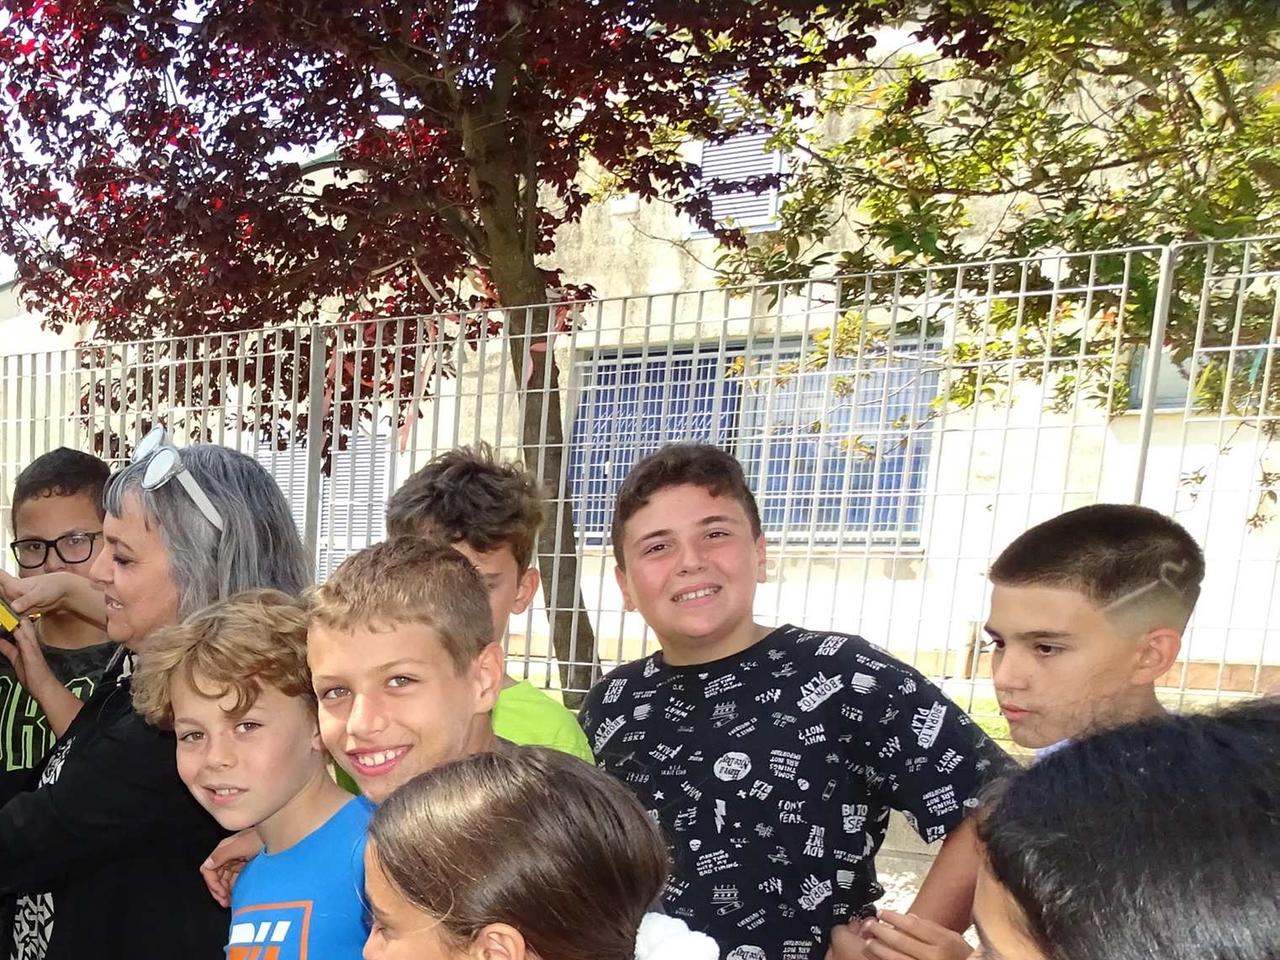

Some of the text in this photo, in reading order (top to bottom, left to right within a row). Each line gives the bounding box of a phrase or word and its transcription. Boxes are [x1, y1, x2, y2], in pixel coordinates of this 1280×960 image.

[800, 671, 826, 697] PLAY
[798, 724, 824, 740] NOT?
[804, 734, 826, 746] WHY
[769, 764, 796, 774] THINGS
[944, 754, 964, 774] WHY
[774, 770, 794, 780] SOME
[753, 780, 774, 794] BLA
[749, 788, 768, 800] BLA
